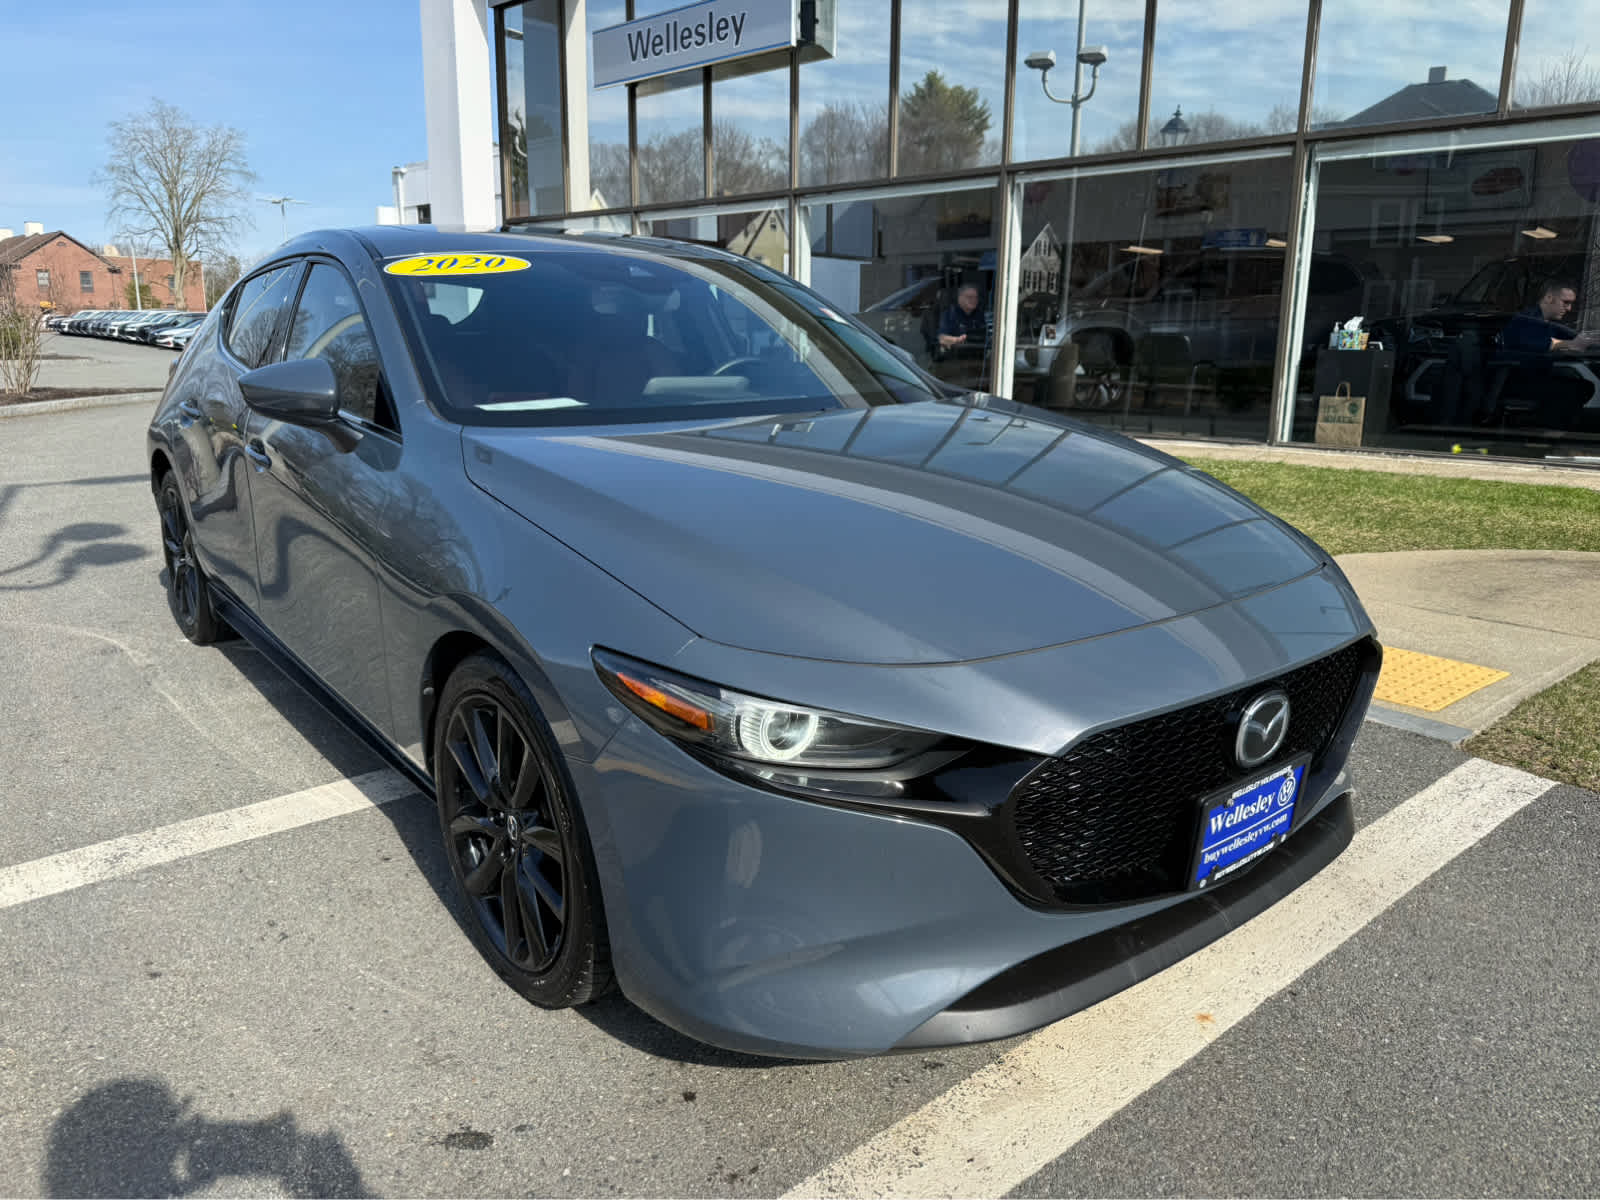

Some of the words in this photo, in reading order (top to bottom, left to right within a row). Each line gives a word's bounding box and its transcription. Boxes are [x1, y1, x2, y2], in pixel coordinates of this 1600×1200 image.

[627, 11, 747, 62] Wellesley
[411, 257, 506, 272] 2020
[1210, 792, 1275, 835] Wellesley
